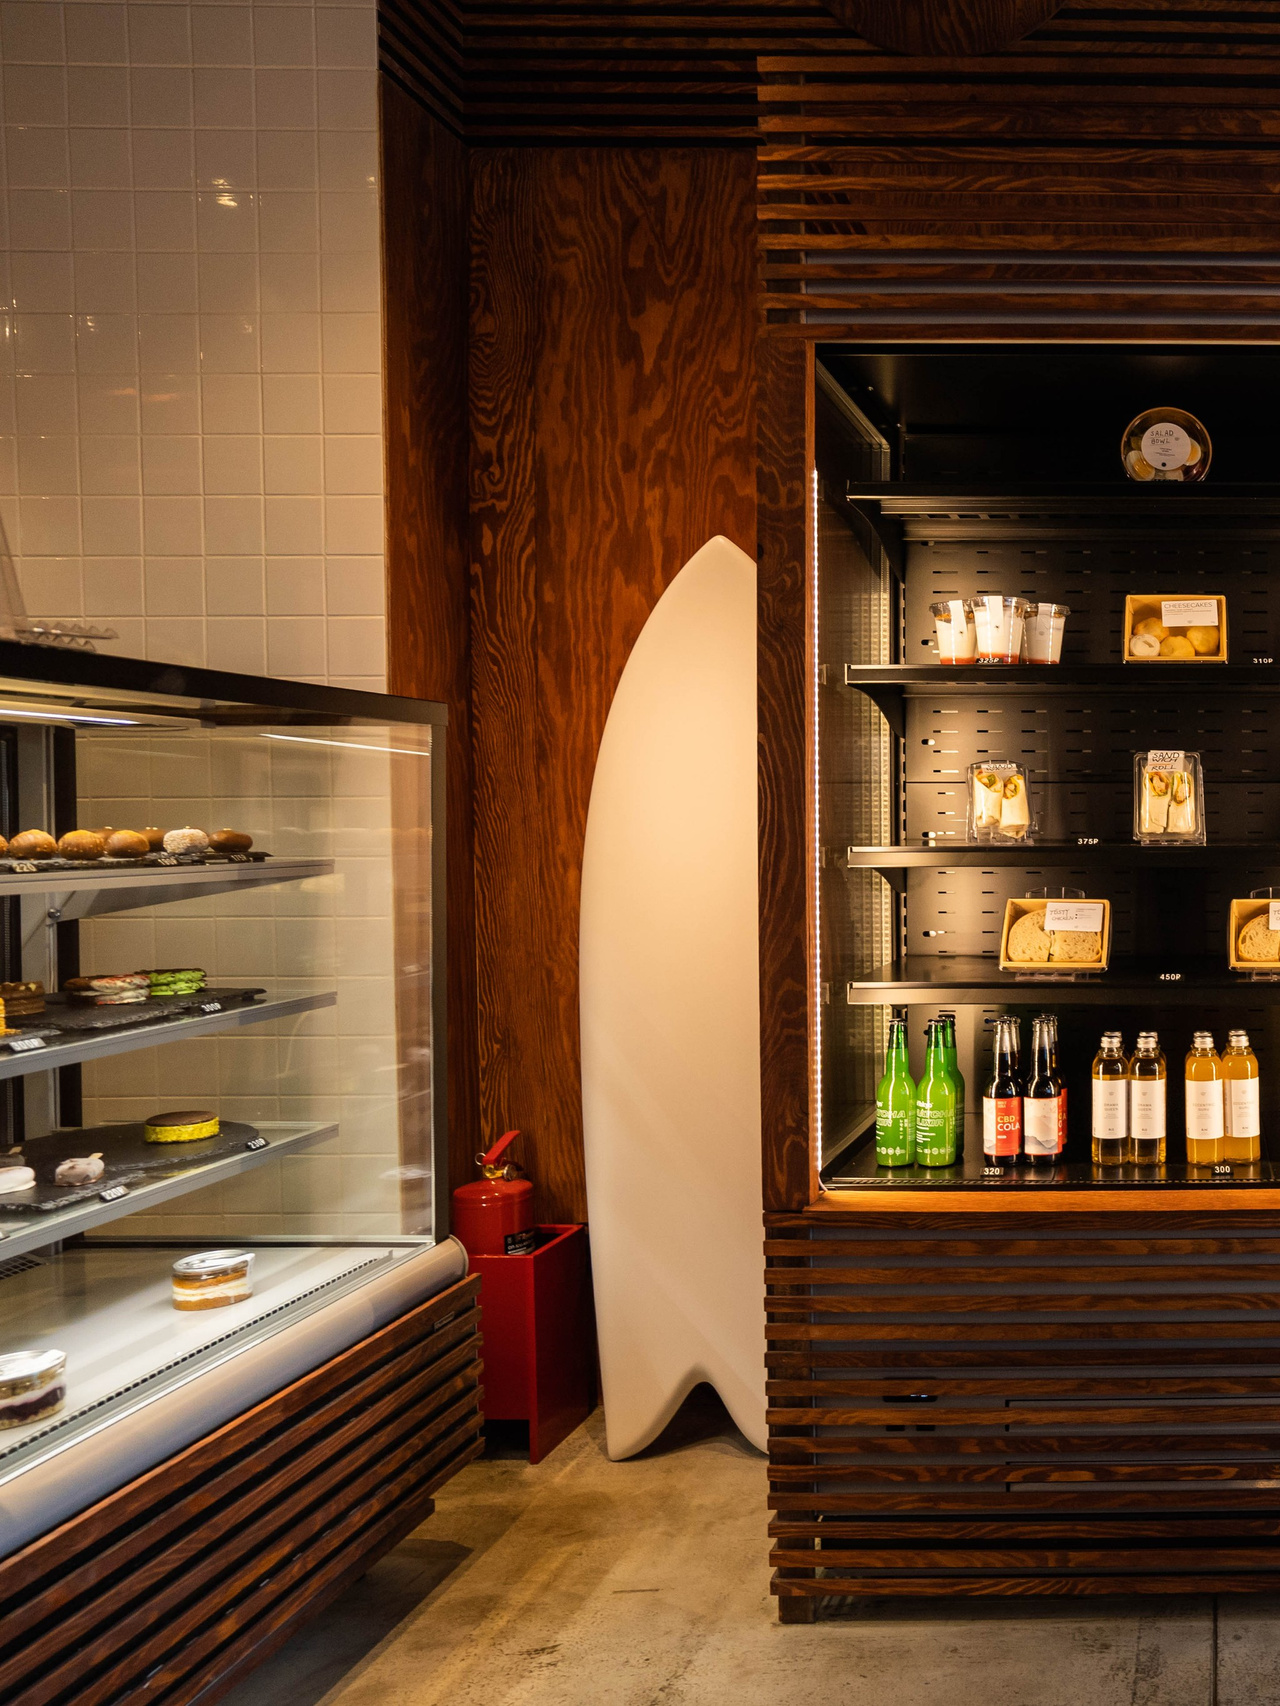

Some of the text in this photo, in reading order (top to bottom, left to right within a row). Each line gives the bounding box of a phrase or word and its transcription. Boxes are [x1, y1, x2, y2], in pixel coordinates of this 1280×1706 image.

[997, 1122, 1020, 1132] COLA
[983, 1167, 1000, 1175] 320
[1214, 1166, 1230, 1174] 300
